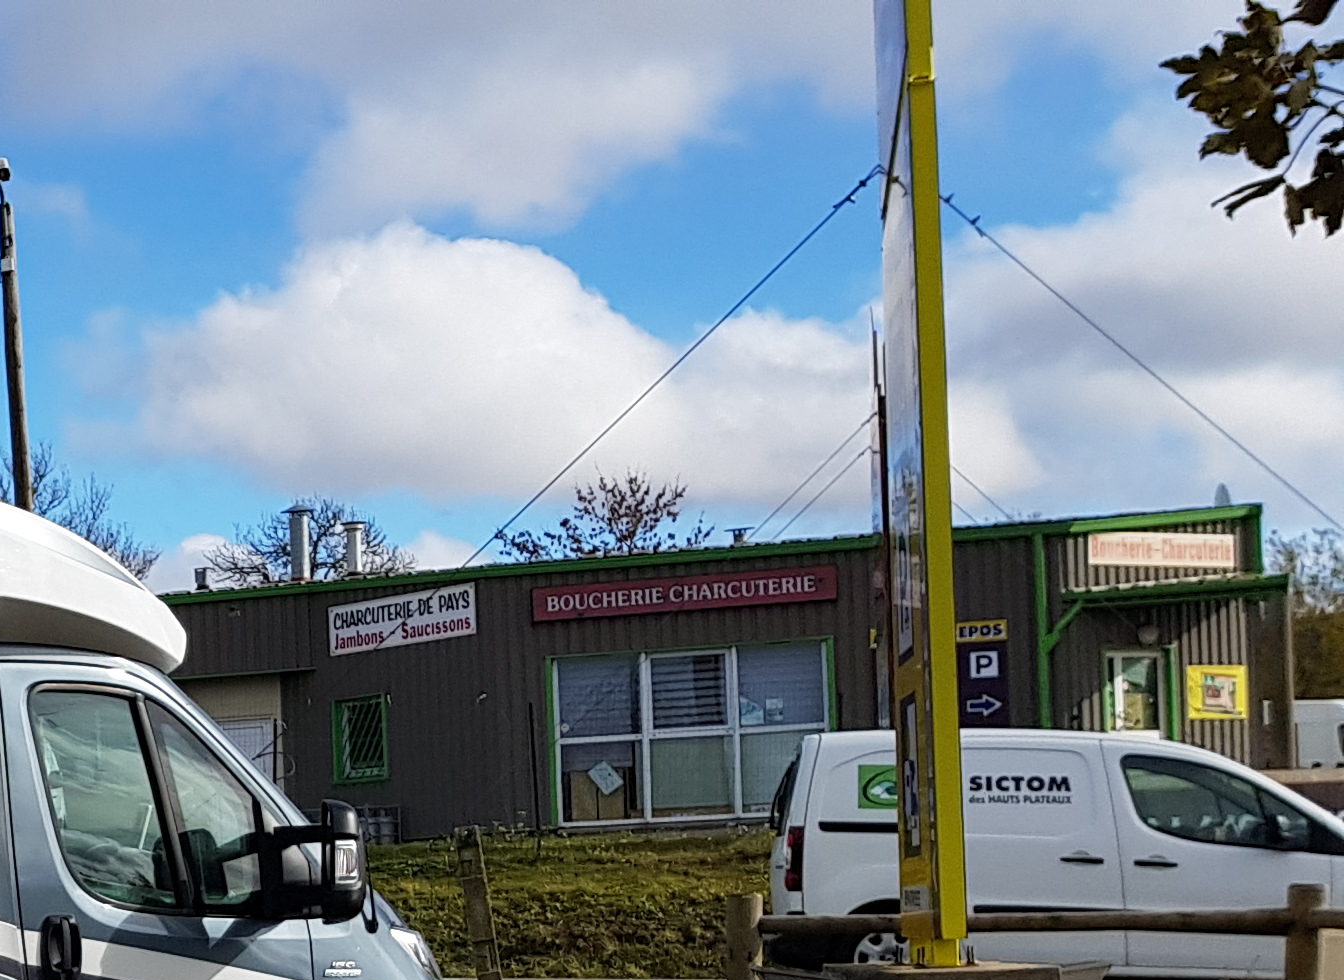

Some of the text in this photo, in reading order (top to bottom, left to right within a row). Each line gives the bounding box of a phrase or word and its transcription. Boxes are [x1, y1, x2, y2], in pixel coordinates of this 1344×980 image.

[547, 575, 816, 612] BOUCHERIE CHARCUTERIE
[333, 590, 470, 630] CHARCUTERIE DE PAYS
[334, 630, 384, 650] Jambons
[401, 617, 471, 639] Saucissons
[976, 655, 993, 675] P
[969, 776, 1071, 792] SICTOM
[988, 795, 1020, 804] HAUTS
[1023, 795, 1072, 804] PLATEAUX
